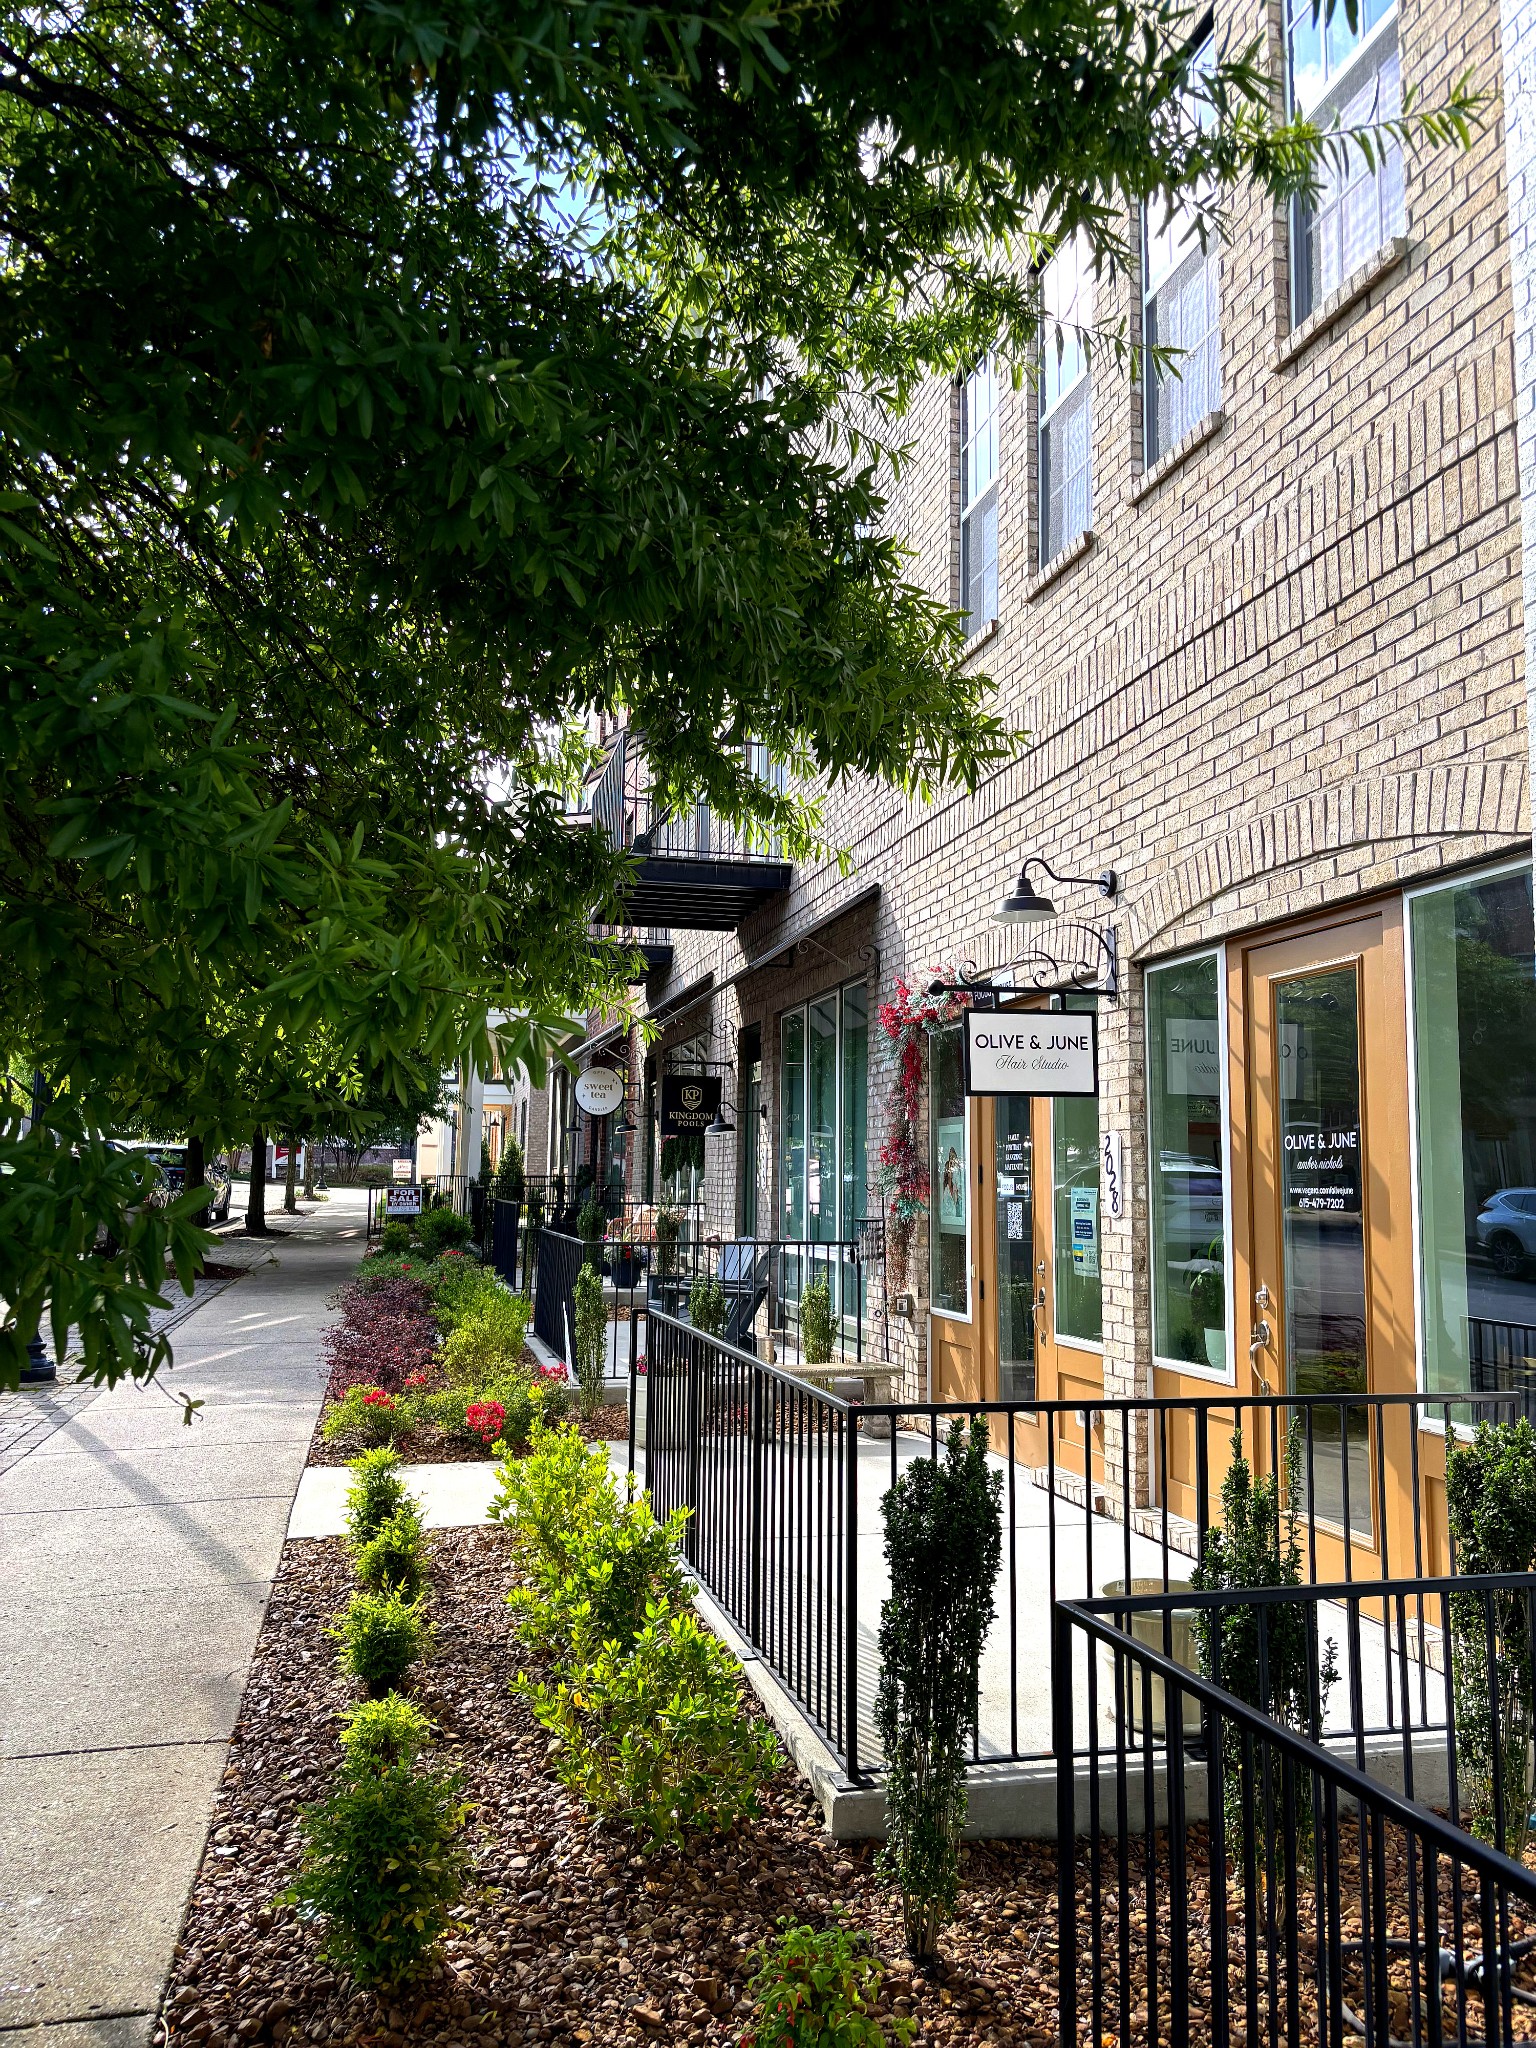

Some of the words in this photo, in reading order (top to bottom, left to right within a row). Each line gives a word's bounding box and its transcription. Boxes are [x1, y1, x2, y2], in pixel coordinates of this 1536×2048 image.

[975, 1034, 1025, 1049] OLIVE
[1029, 1034, 1041, 1049] &
[1046, 1035, 1089, 1051] JUNE
[995, 1054, 1028, 1070] Hair
[1031, 1055, 1070, 1071] Studio
[584, 1083, 613, 1091] sweet
[590, 1091, 607, 1099] tea
[684, 1089, 700, 1100] KP
[669, 1111, 714, 1121] KINGDOM
[1284, 1134, 1315, 1151] OLIVE
[1317, 1133, 1326, 1149] &
[1328, 1131, 1357, 1149] JUNE
[1296, 1155, 1318, 1170] amber
[1318, 1154, 1344, 1170] nichols
[1104, 1134, 1119, 1214] 2028
[1298, 1197, 1345, 1210] 615-479-7202
